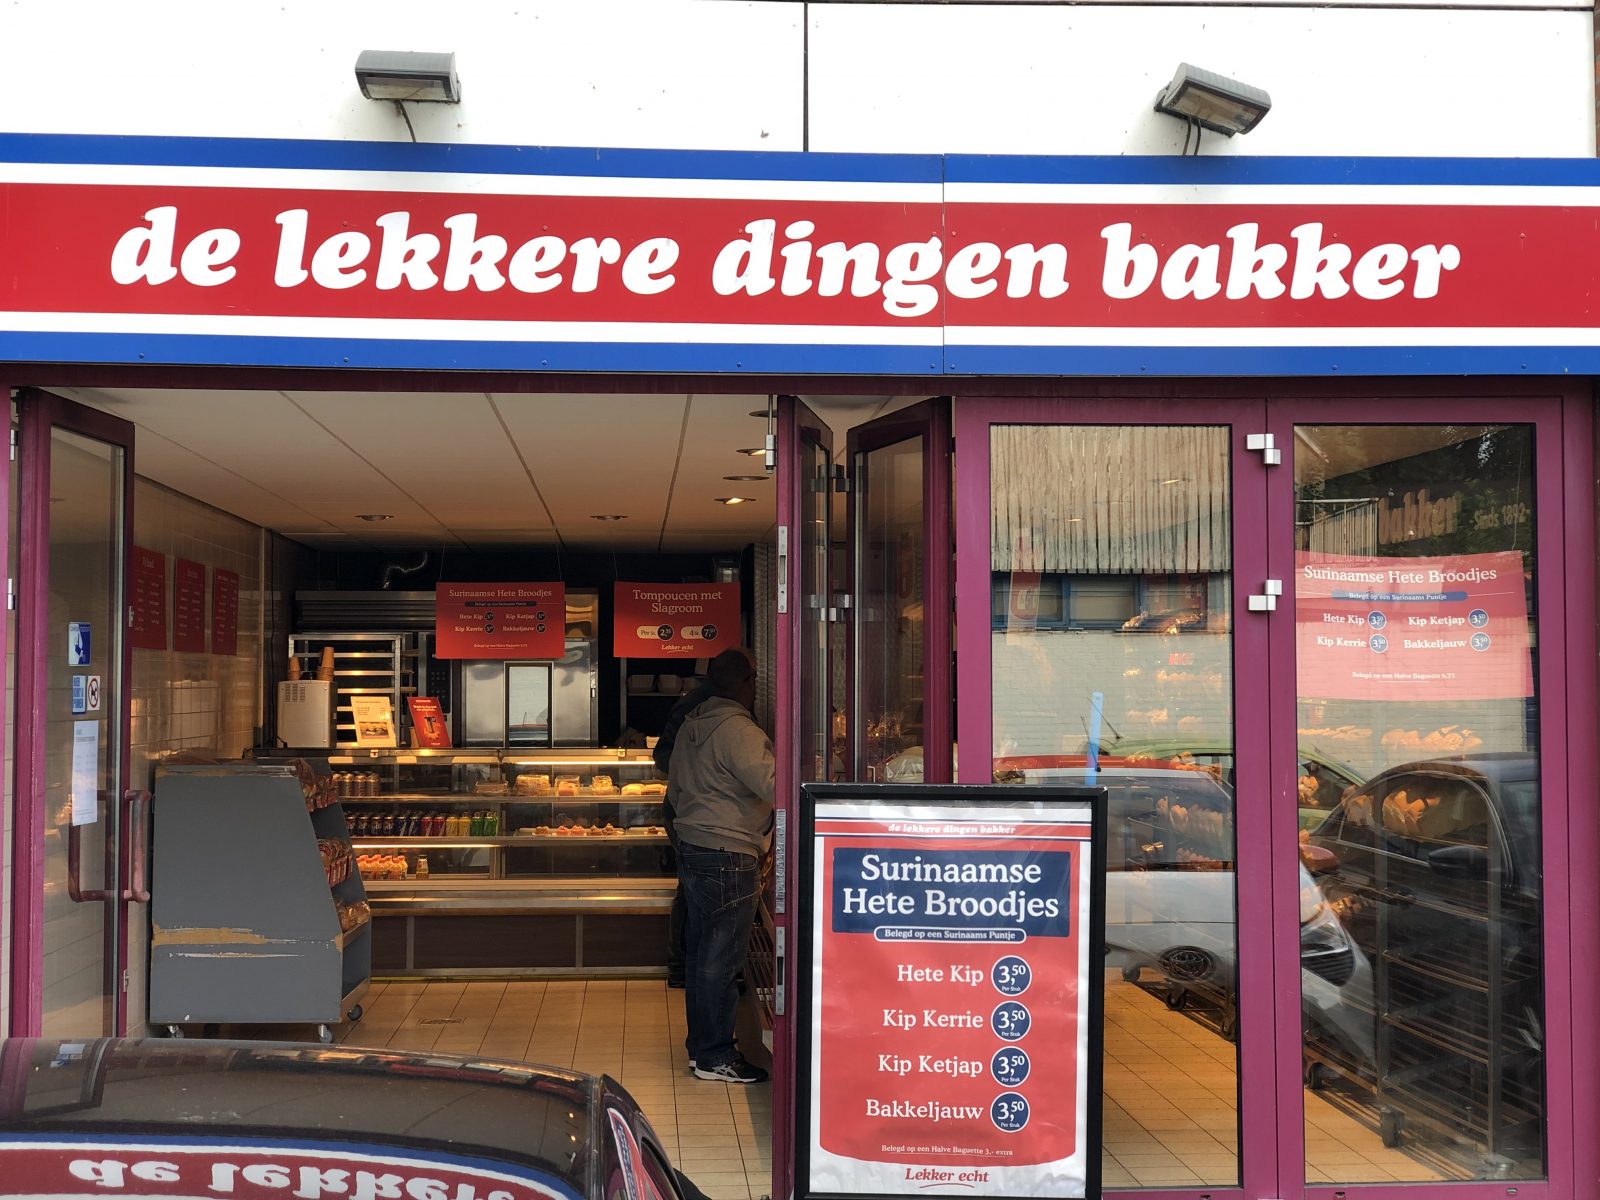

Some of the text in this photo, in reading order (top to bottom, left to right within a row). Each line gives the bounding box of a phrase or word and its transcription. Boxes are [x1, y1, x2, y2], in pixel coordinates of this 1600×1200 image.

[110, 205, 1461, 318] de lekkere dingen bakker
[1304, 565, 1497, 585] Surinaamse Hete Broodjes
[449, 588, 552, 598] Surinaamse Hete Broodjes
[633, 589, 722, 602] Tompoucen met
[652, 602, 703, 615] Slagroom
[1323, 613, 1345, 623] Hete
[1348, 613, 1364, 625] Kip
[1408, 616, 1426, 627] Kip
[1430, 616, 1465, 627] Ketjap
[1317, 636, 1333, 647] Kip
[1336, 637, 1366, 648] Kerrie
[1403, 639, 1467, 650] Bakkeljauw
[888, 823, 900, 832] de
[943, 824, 978, 834] dingen
[980, 824, 1016, 834] bakker
[860, 853, 1042, 885] Surinaamse
[842, 887, 1060, 923] Hete Broodjes
[884, 928, 913, 940] Belegd
[914, 931, 926, 940] op
[944, 929, 987, 939] Surinaams
[989, 931, 1016, 941] Puntje
[897, 964, 1027, 986] Hete Kip 3,50
[883, 1009, 1026, 1031] Kip Kerrie 3,50
[878, 1054, 1025, 1078] Kip Ketjap 3,50
[866, 1099, 1025, 1122] Bakkeljauw 3,50
[881, 1144, 905, 1153] Belegd
[906, 1146, 916, 1154] op
[931, 1145, 951, 1153] Halve
[952, 1146, 984, 1155] Baguette
[905, 1167, 989, 1182] Lekker echt
